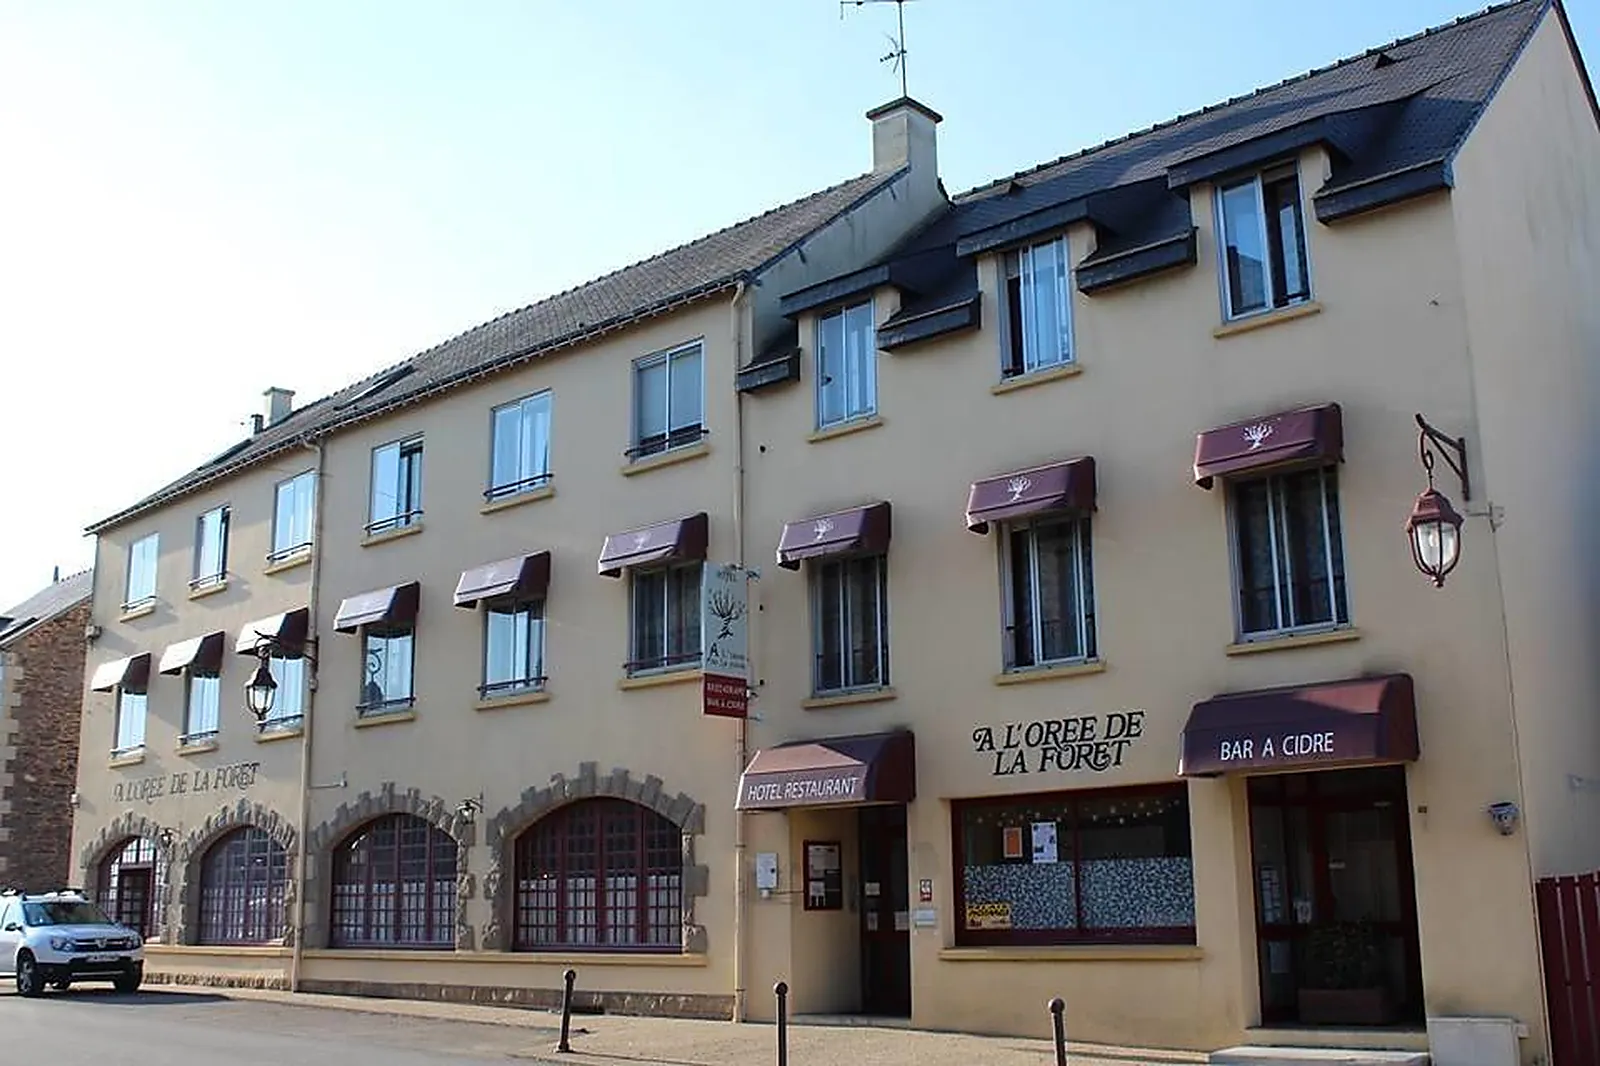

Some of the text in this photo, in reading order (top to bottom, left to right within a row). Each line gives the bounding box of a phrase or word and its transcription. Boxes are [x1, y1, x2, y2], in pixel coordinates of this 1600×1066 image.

[972, 711, 1145, 752] A L'OREE DE
[993, 740, 1131, 776] LA FORET
[1220, 732, 1334, 761] BAR A CIDRE
[169, 772, 189, 795] DE
[192, 770, 210, 792] LA
[747, 777, 859, 801] HOTEL RESTAURANT
